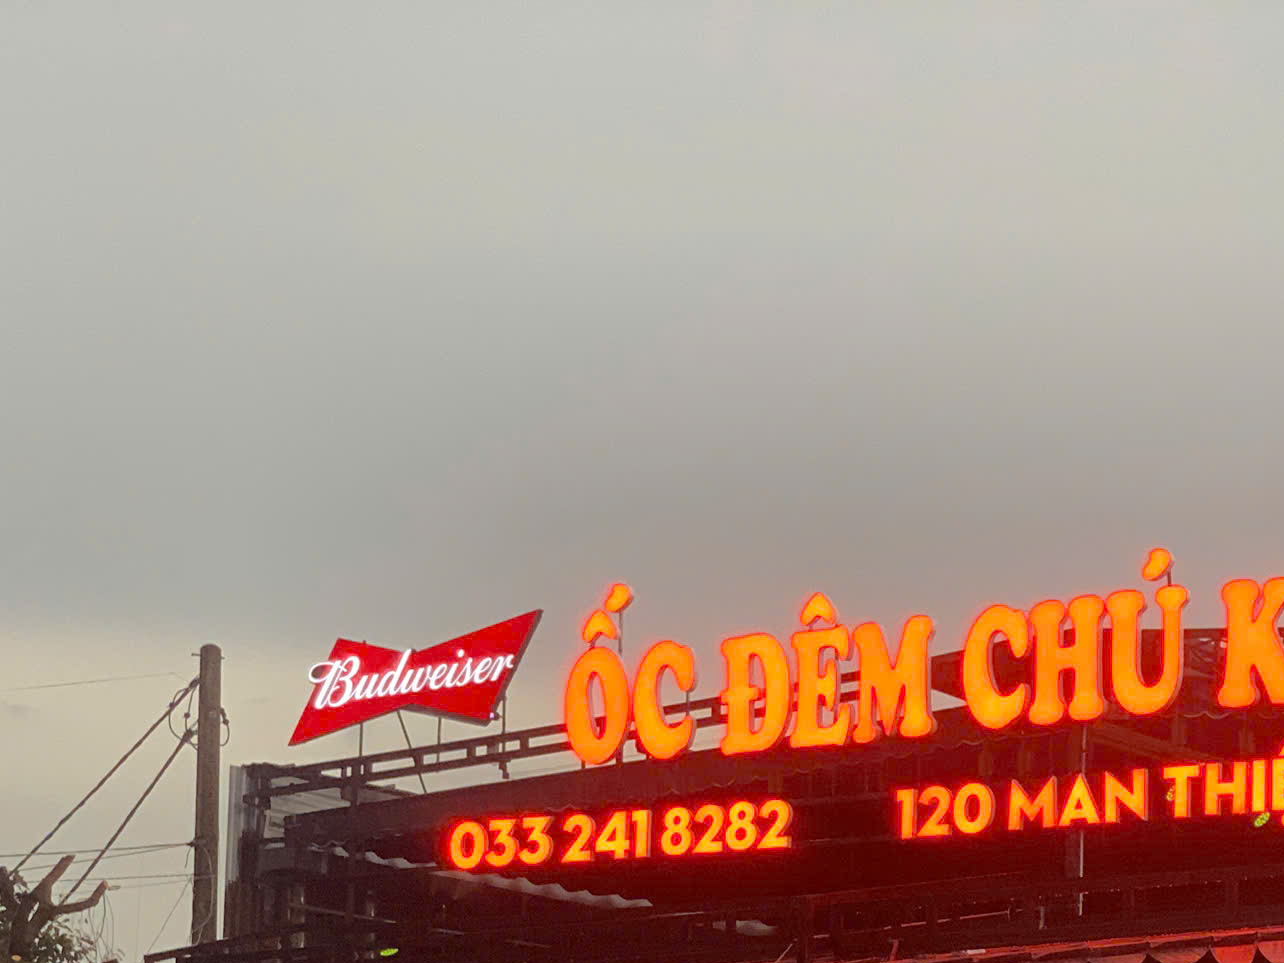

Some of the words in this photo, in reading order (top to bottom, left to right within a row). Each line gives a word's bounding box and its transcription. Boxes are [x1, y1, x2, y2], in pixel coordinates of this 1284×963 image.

[308, 648, 515, 710] Budweiser
[564, 583, 697, 765] ỐC
[719, 591, 936, 755] ĐÊM
[961, 548, 1189, 729] CHÚ
[448, 816, 554, 870] 033
[561, 809, 651, 863] 241
[661, 800, 792, 856] 8282
[896, 784, 995, 840] 120
[1008, 768, 1148, 832] MAN
